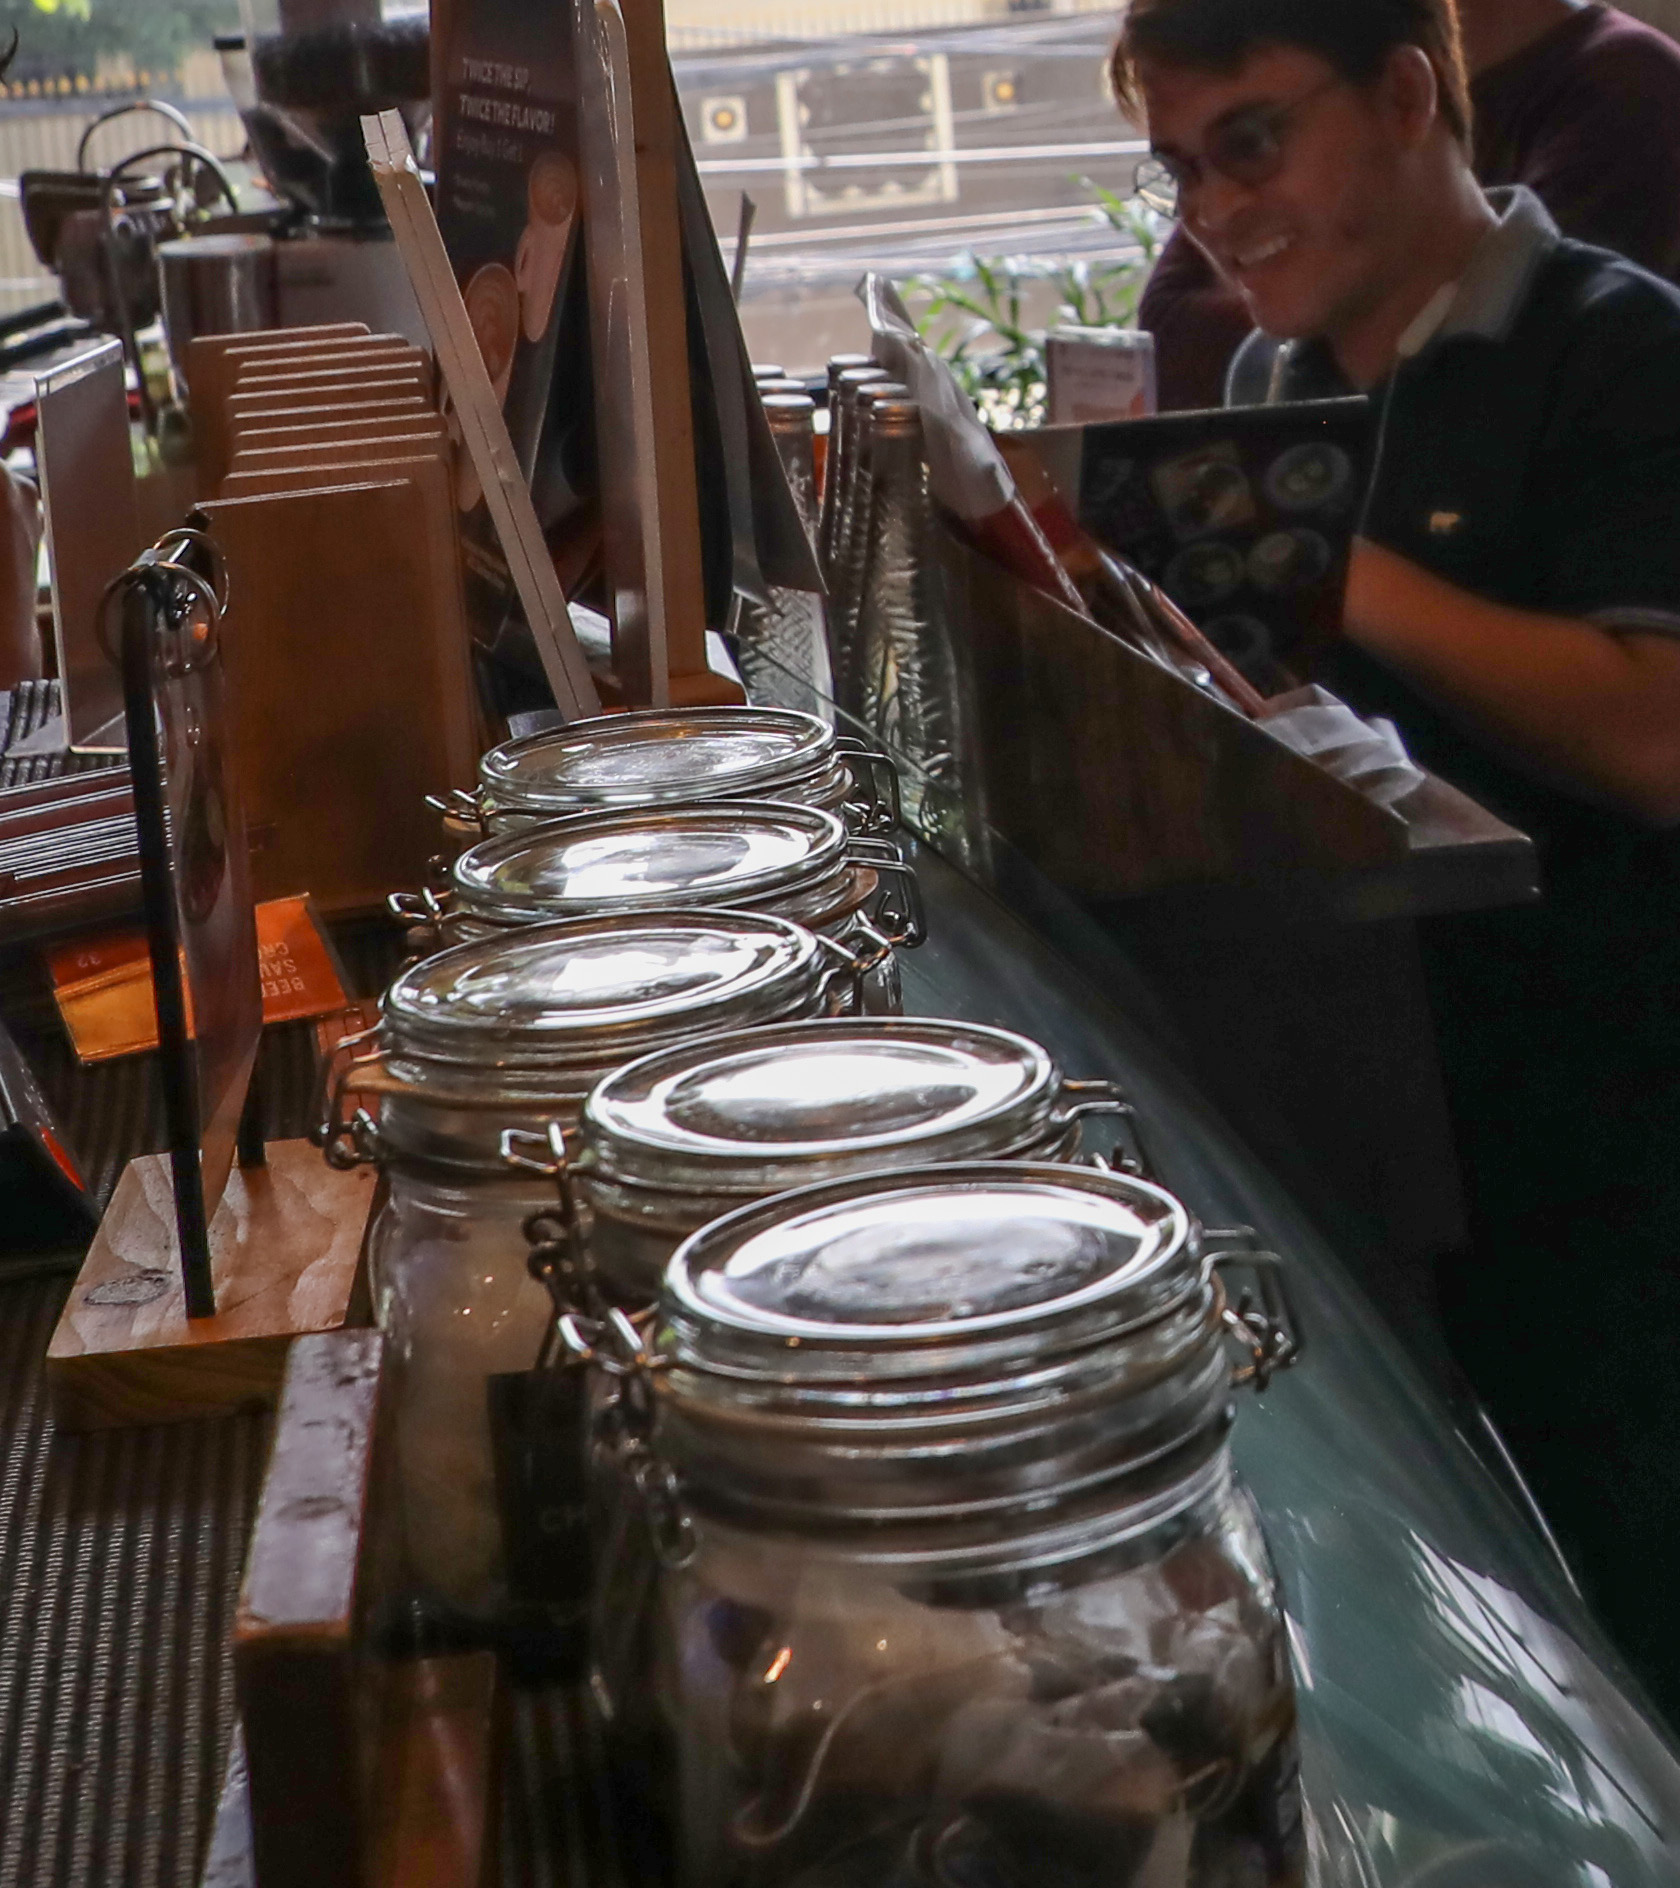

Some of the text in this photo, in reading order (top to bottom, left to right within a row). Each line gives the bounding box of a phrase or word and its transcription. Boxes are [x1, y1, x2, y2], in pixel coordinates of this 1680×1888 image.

[459, 94, 556, 135] TWICE THE FLAVOR!
